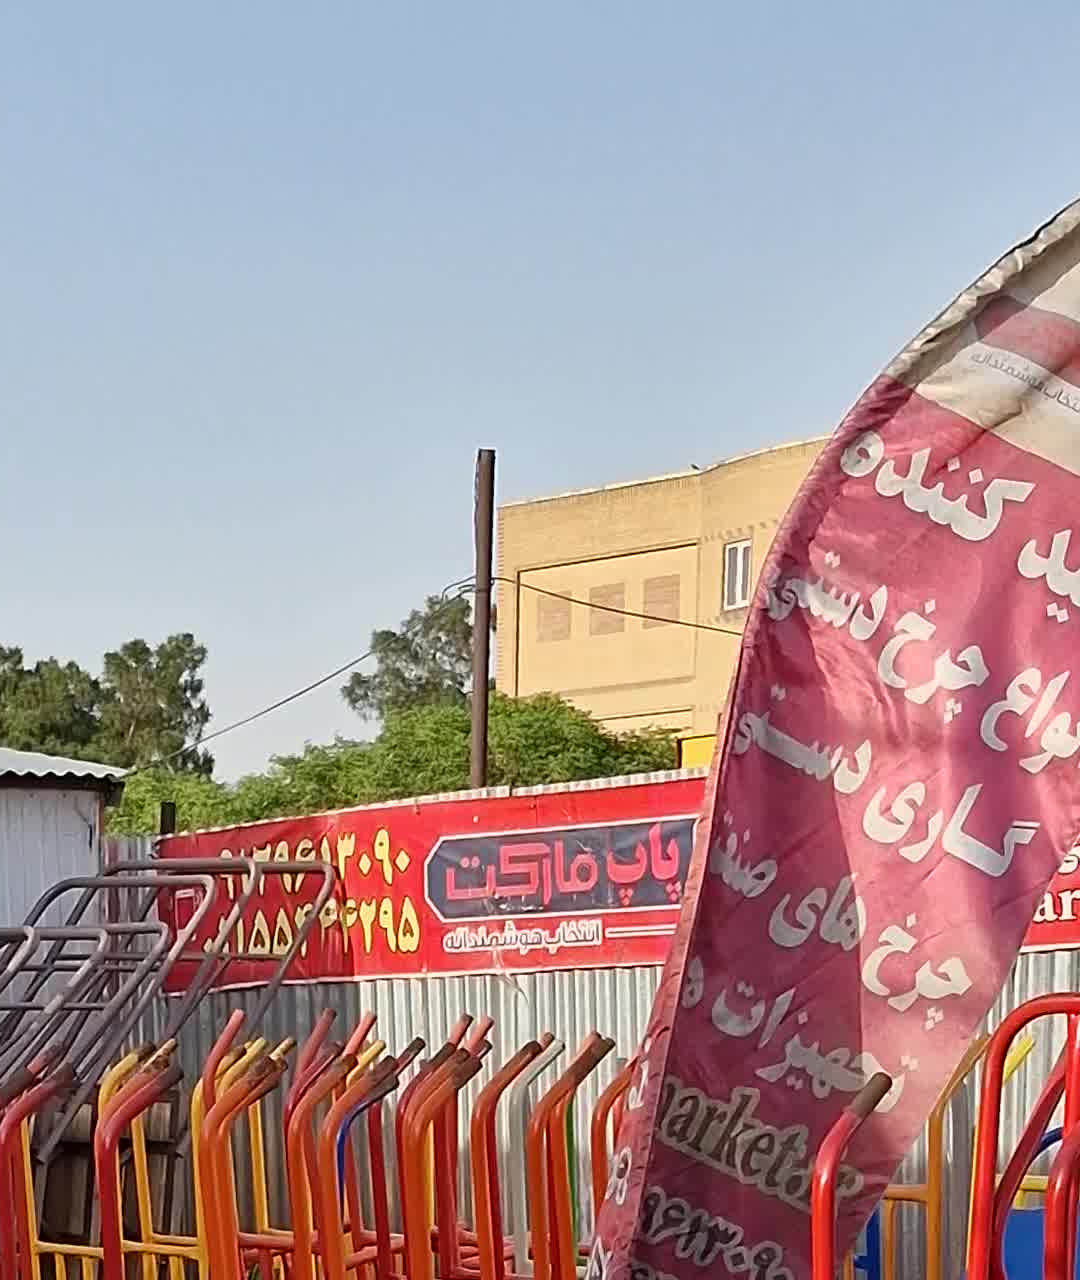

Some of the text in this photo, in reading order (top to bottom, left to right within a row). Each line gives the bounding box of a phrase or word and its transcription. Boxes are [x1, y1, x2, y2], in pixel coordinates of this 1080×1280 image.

[839, 430, 1037, 542] کننده
[765, 551, 888, 641] دستی
[877, 599, 991, 723] چرخ
[978, 667, 1080, 775] واع
[731, 682, 1042, 878] گاری دستی
[445, 822, 683, 906] پاپ مارکت
[769, 871, 867, 951] های
[544, 918, 603, 954] انتخاب
[861, 911, 973, 1032] چرخ
